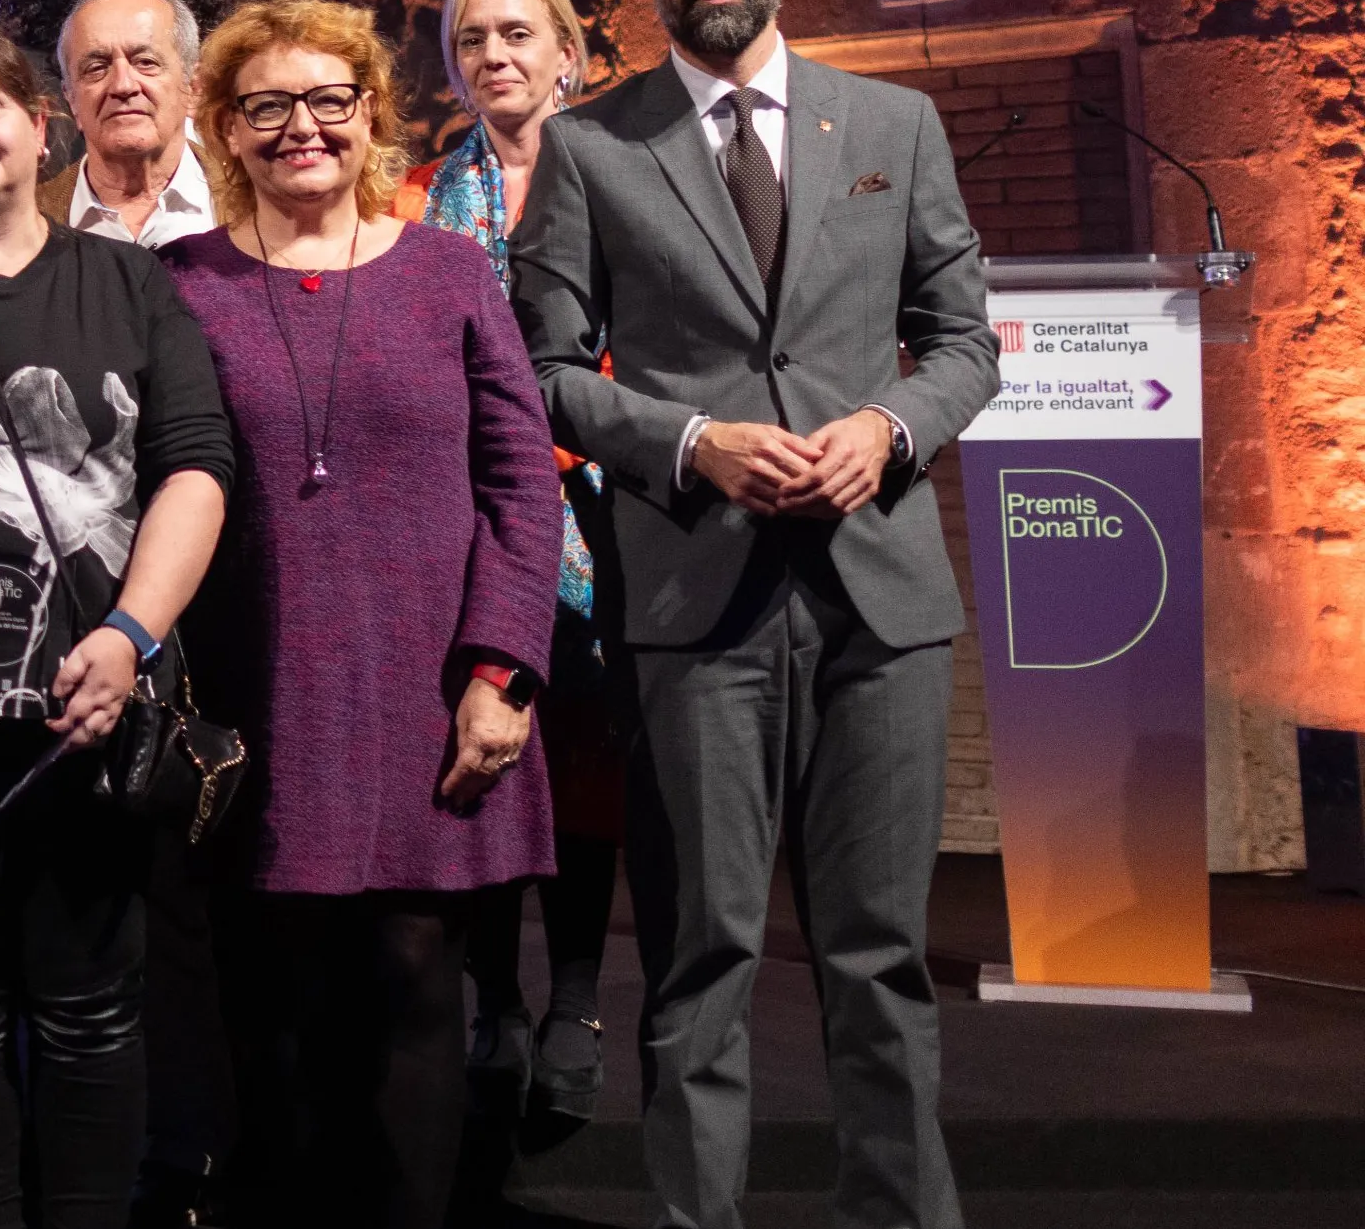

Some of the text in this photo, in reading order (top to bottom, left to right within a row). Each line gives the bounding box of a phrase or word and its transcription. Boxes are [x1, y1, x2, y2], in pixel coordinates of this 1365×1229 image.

[1032, 322, 1130, 337] Generalitat
[1033, 339, 1149, 355] de Catalunya
[999, 379, 1135, 397] Per la igualtat,
[1049, 396, 1135, 411] endavant
[1007, 493, 1098, 515] Premis
[1008, 515, 1124, 539] DonaTIC
